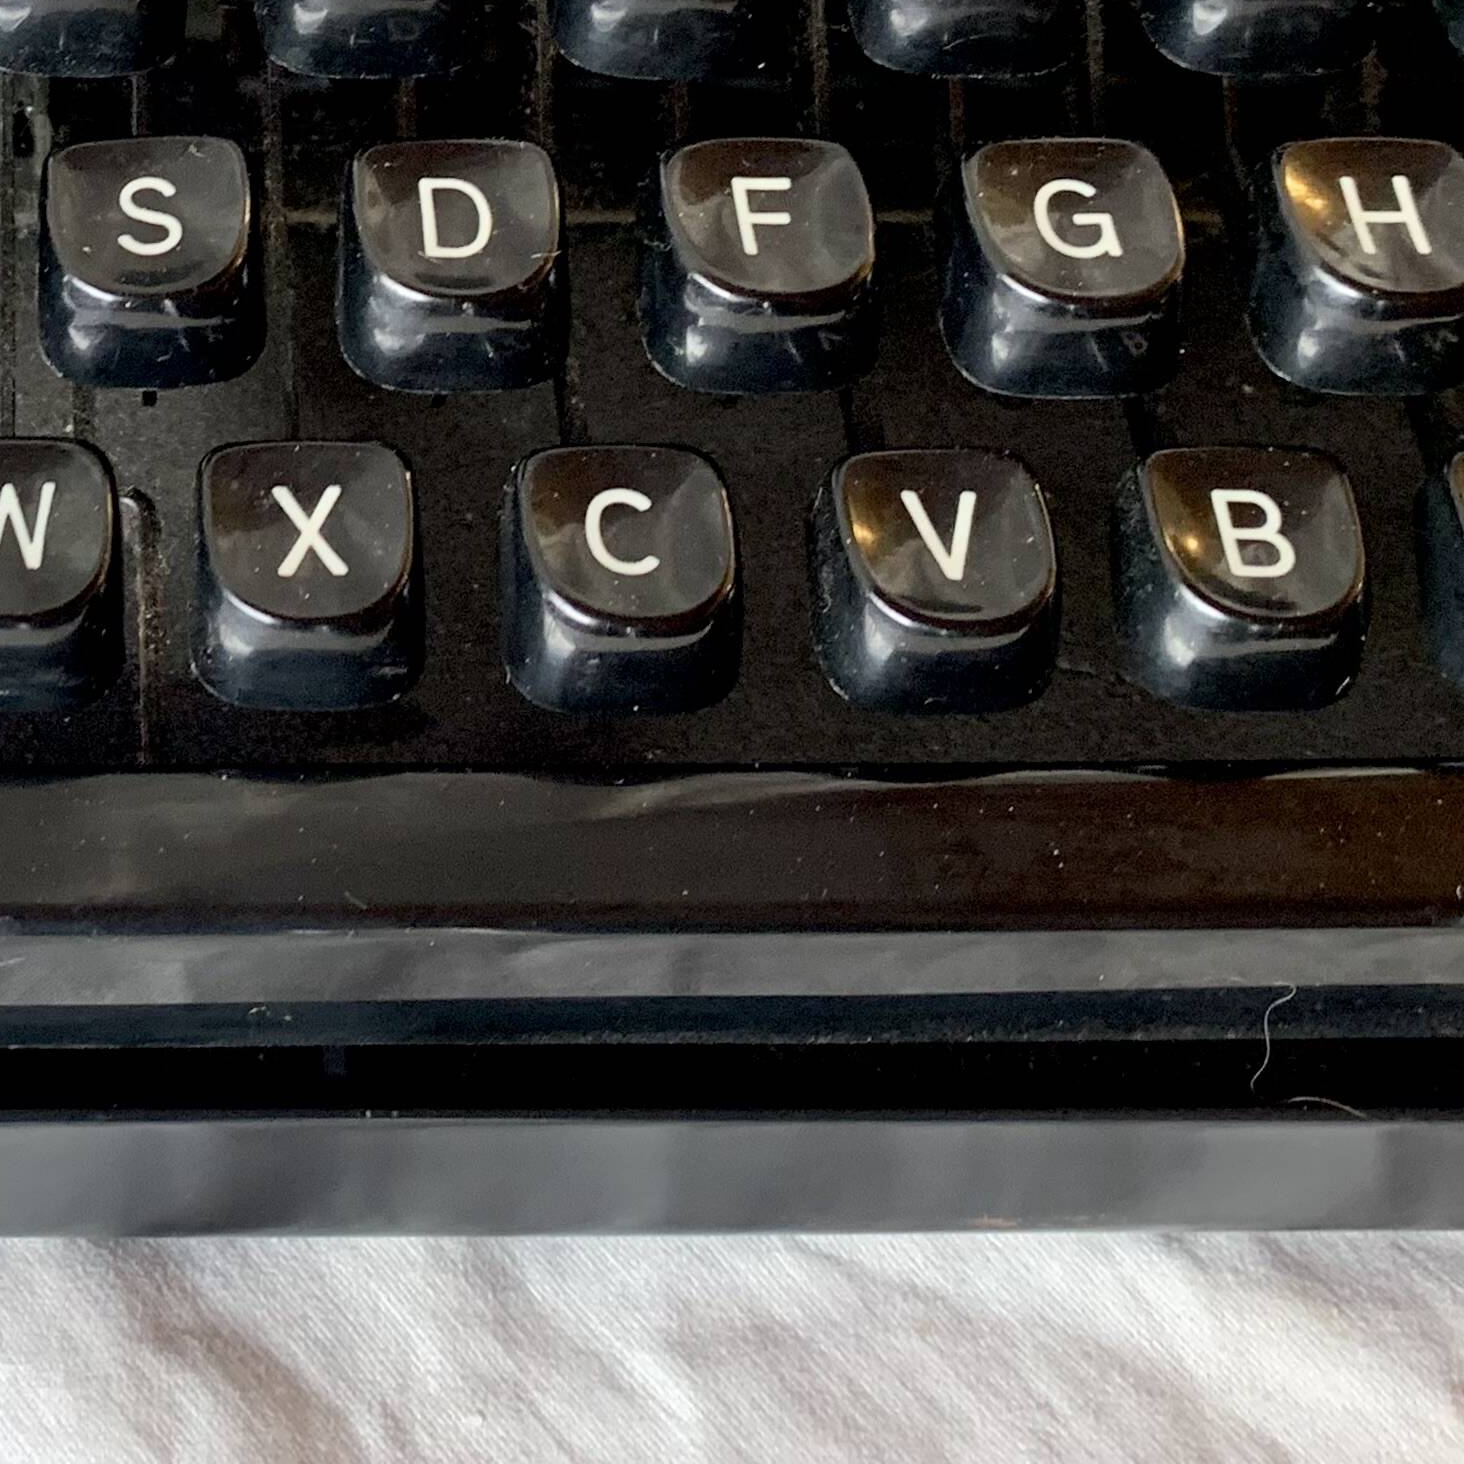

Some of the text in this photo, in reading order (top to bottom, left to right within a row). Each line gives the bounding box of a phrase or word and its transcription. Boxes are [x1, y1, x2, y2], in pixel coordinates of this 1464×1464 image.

[117, 176, 183, 256] S
[418, 177, 492, 258] D
[731, 177, 792, 255] F
[1033, 179, 1123, 259] G
[1339, 175, 1432, 255] H
[271, 485, 349, 577] X
[585, 488, 660, 576] C
[900, 490, 977, 581] V
[1210, 489, 1295, 578] B
